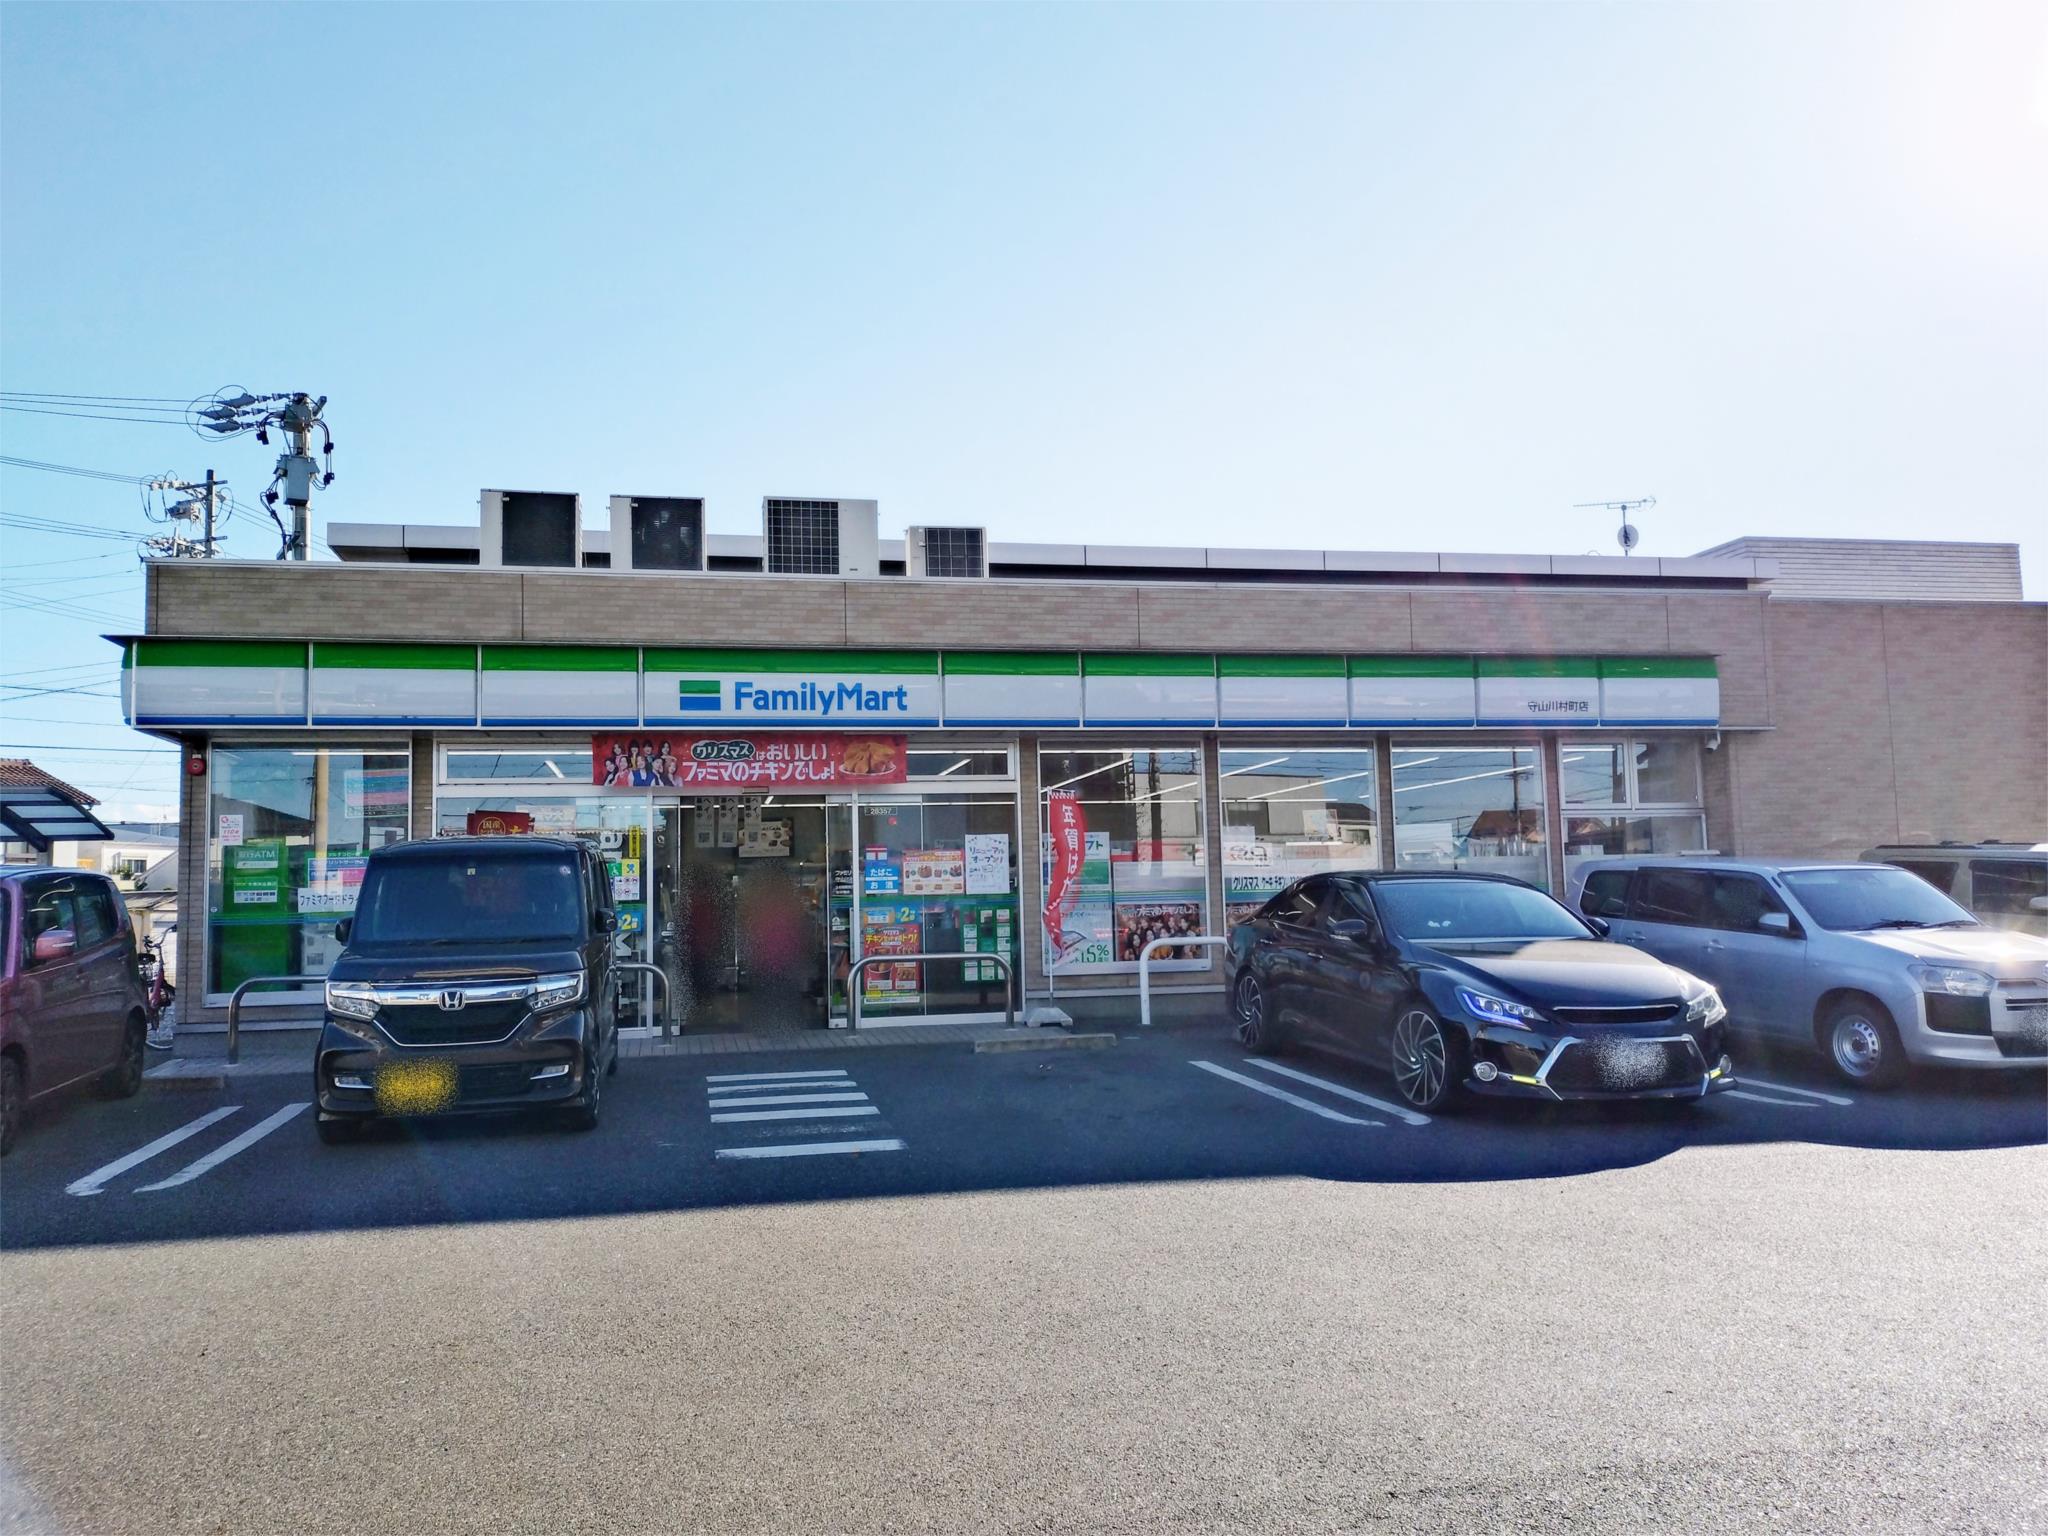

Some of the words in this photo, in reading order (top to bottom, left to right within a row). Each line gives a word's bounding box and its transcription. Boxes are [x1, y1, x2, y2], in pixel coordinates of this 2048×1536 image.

[735, 682, 908, 715] FamilyMart
[1528, 701, 1589, 712] 守山川村町店
[870, 868, 893, 876] たばこ
[871, 881, 893, 890] お酒
